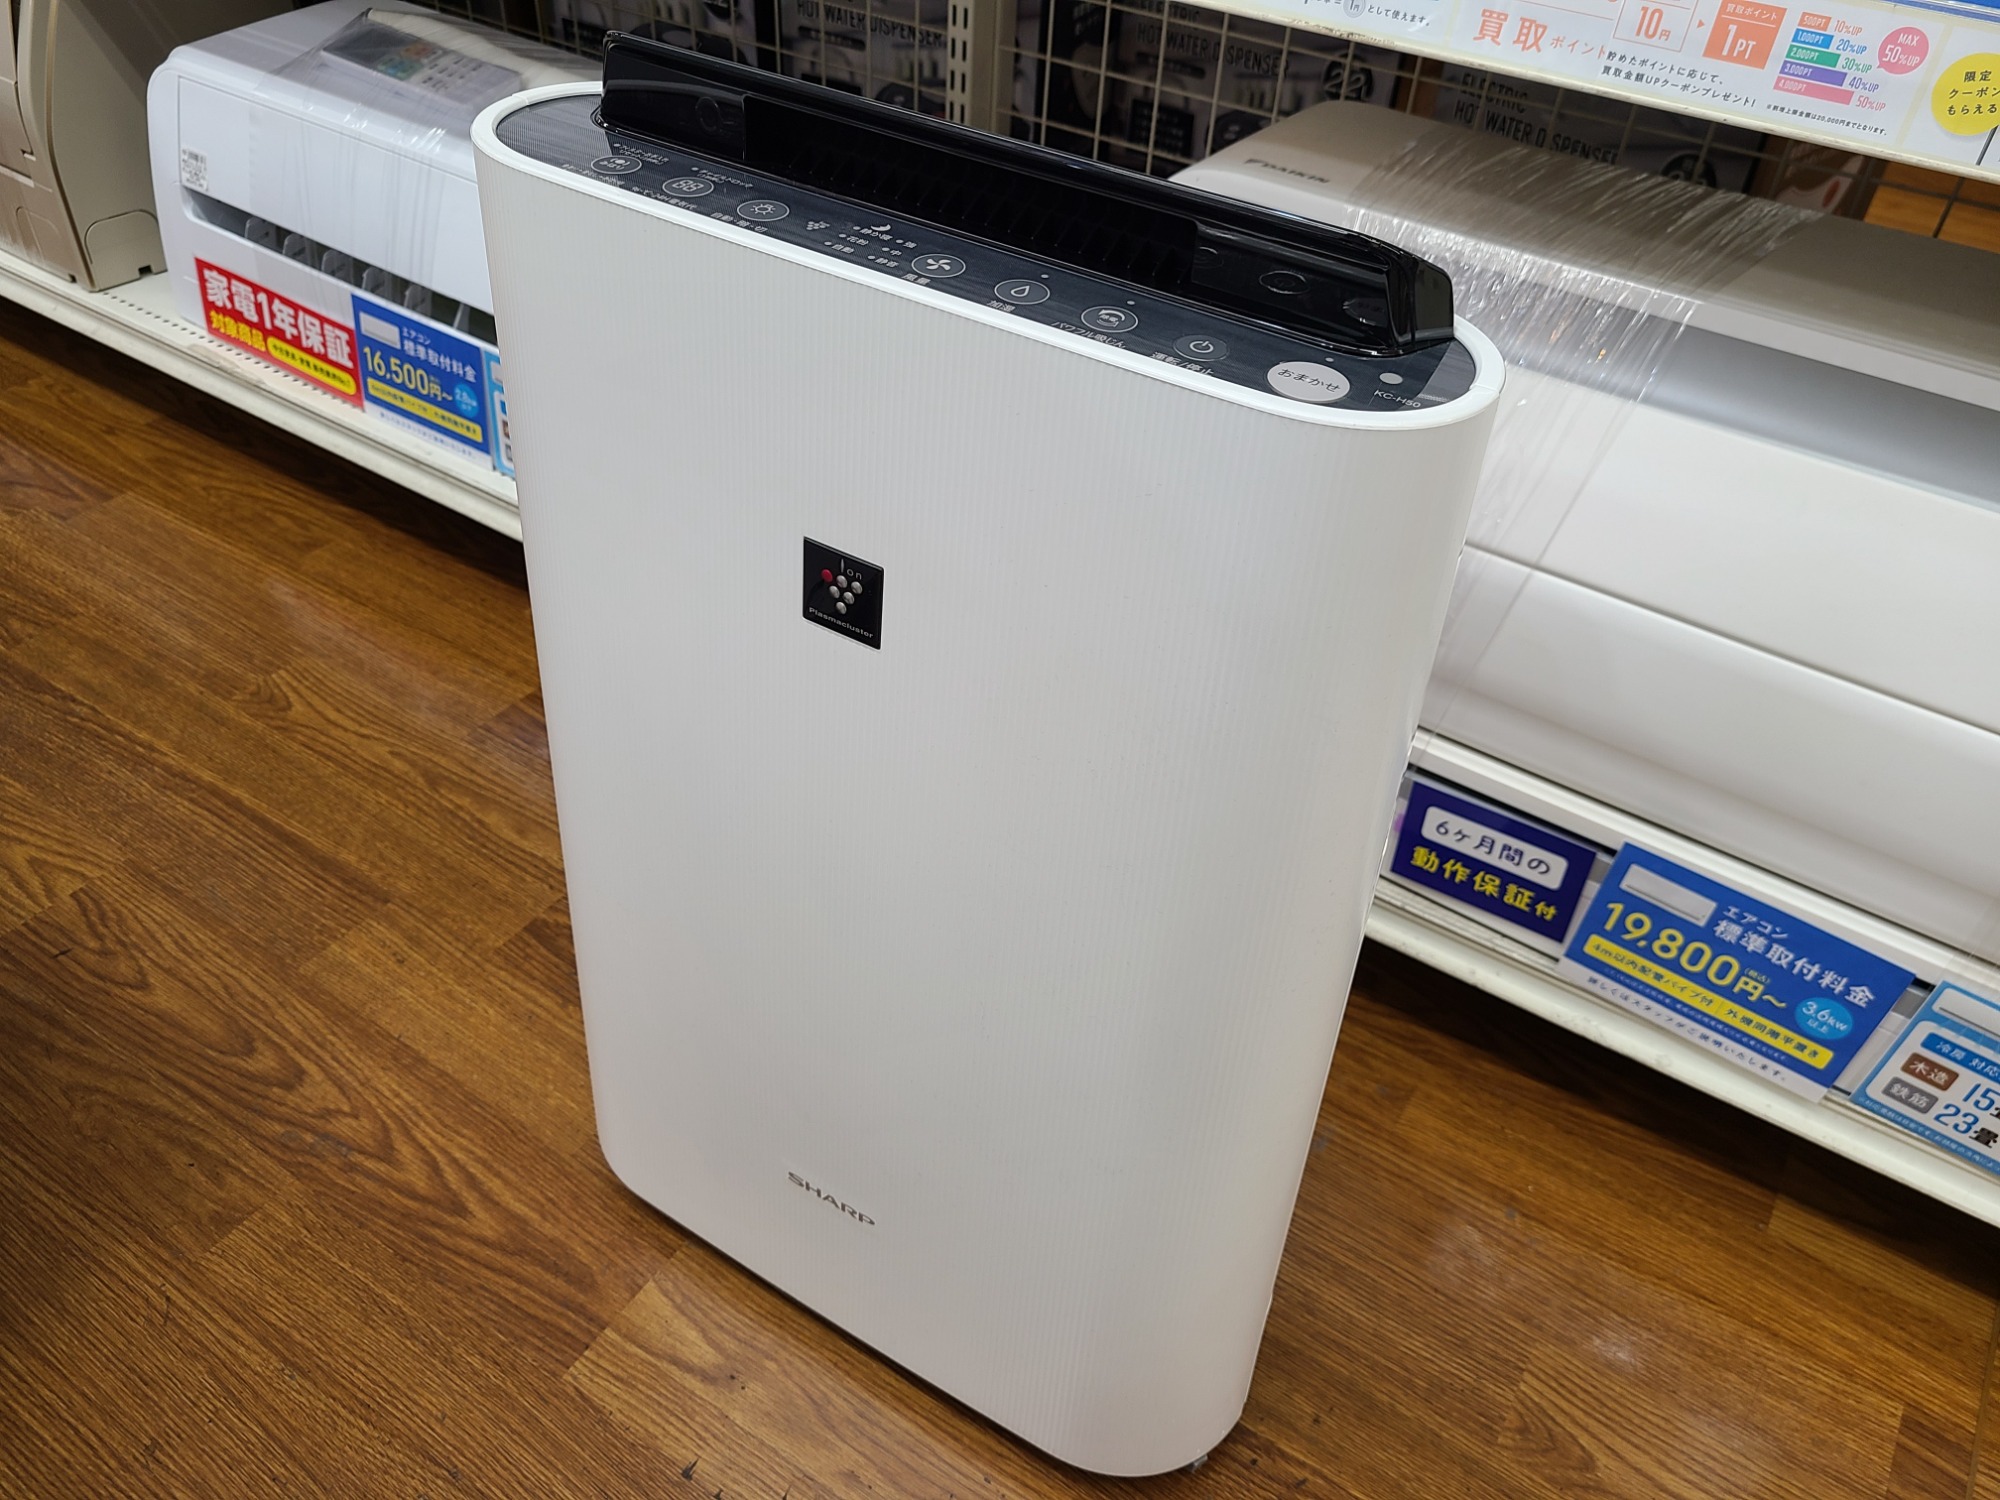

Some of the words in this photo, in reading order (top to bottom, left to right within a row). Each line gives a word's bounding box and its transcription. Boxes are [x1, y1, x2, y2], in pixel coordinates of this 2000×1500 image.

[1635, 6, 1671, 42] 10円
[1725, 3, 1778, 21] 買取ポイント
[1472, 8, 1548, 52] 買取
[1550, 35, 1608, 60] ポイント
[1834, 20, 1863, 36] 10%UP
[1897, 33, 1920, 47] MAX
[1836, 39, 1867, 55] 20%UP
[1882, 45, 1920, 67] 50%UP
[1606, 50, 1725, 85] 貯めたポイントに応じて、
[1841, 57, 1872, 74] 30%UP
[1963, 70, 1992, 83] 限定
[1848, 76, 1880, 93] 40%UP
[1855, 95, 1887, 112] 50%UP
[1946, 105, 1998, 115] もらえる
[1485, 108, 1532, 144] WATER
[202, 267, 354, 369] 家電1年保証
[403, 339, 477, 383] 標準取付料金
[1277, 367, 1342, 393] おまかせ
[1373, 389, 1422, 409] KC-H50
[839, 558, 862, 580] Ion
[808, 607, 874, 639] Plasmacluster
[1410, 845, 1558, 922] 動作保証付
[1722, 904, 1790, 940] エアコン
[1712, 919, 1877, 1010] 標準取付料金
[1909, 1059, 1949, 1086] 木造
[1889, 1081, 1932, 1109] 鉄筋
[787, 1170, 876, 1226] SHARP
